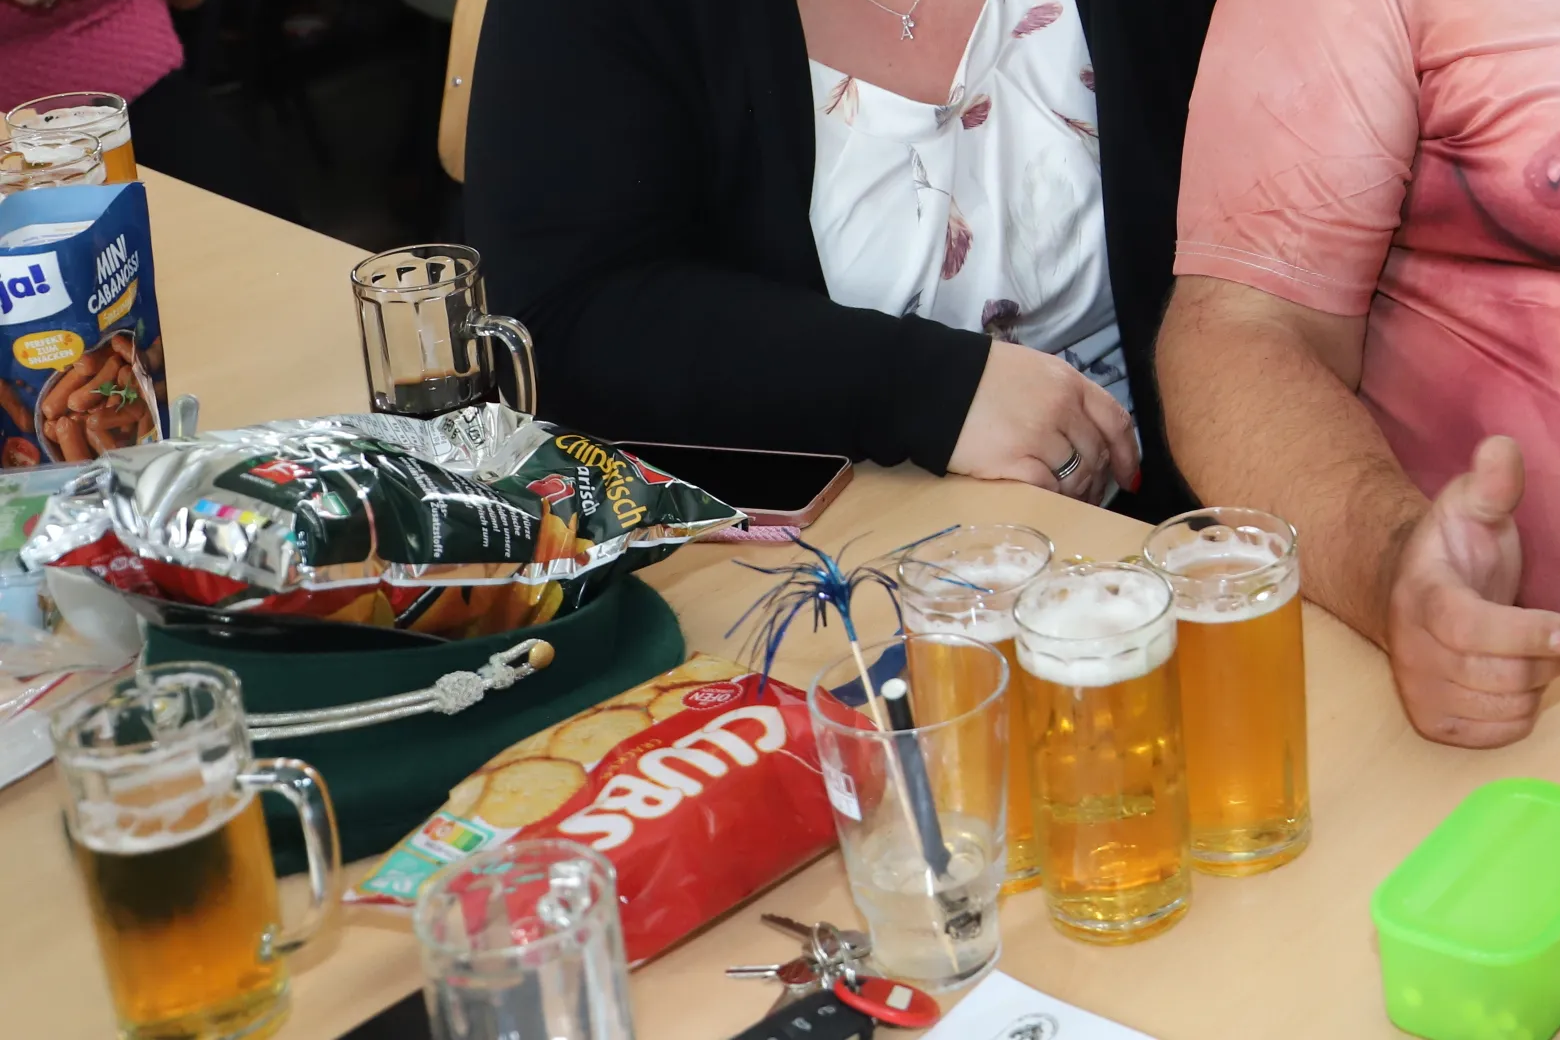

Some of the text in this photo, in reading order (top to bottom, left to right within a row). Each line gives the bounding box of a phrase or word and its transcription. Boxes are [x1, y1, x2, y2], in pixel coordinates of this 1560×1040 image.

[96, 233, 128, 285] MINI
[24, 333, 64, 349] PERFEKT
[36, 344, 58, 356] ZUM
[28, 348, 74, 365] SNACKEN
[430, 501, 444, 559] Zusatzstoffe
[481, 526, 489, 548] zum
[503, 527, 511, 558] unsere
[688, 691, 732, 702] OFEN
[557, 704, 787, 851] CLUBS
